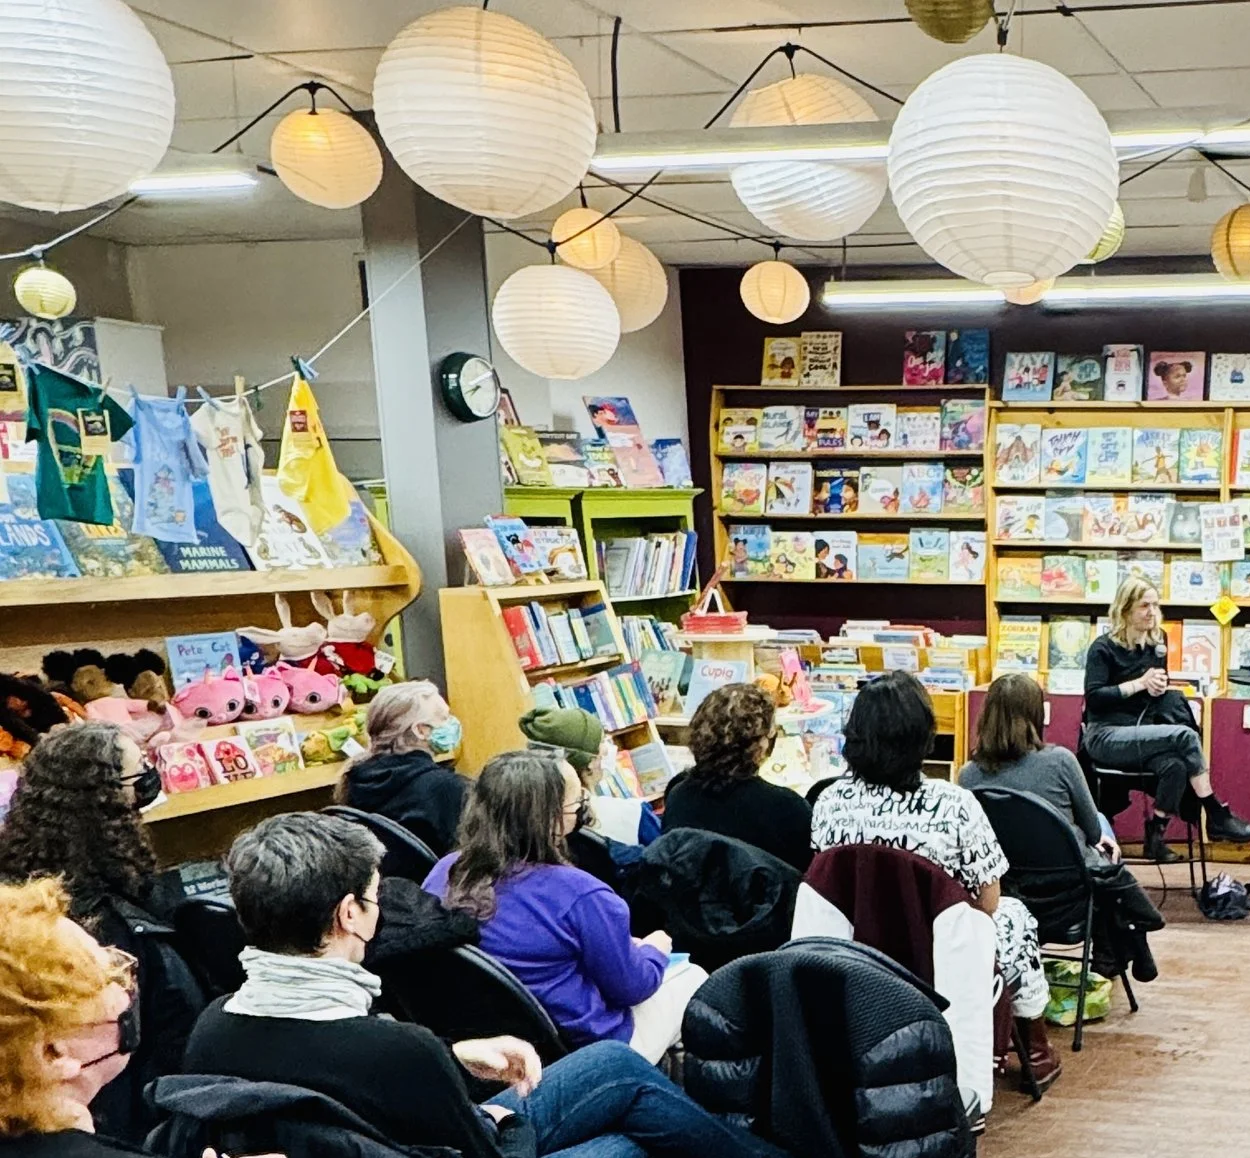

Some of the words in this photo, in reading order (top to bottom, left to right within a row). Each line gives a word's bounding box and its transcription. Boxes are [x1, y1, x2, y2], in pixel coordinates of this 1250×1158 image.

[180, 546, 227, 558] MARINE
[179, 558, 239, 570] MAMMALS
[177, 643, 203, 657] Pete
[211, 640, 231, 654] Cat
[700, 664, 734, 680] Cupig
[217, 753, 250, 774] LO
